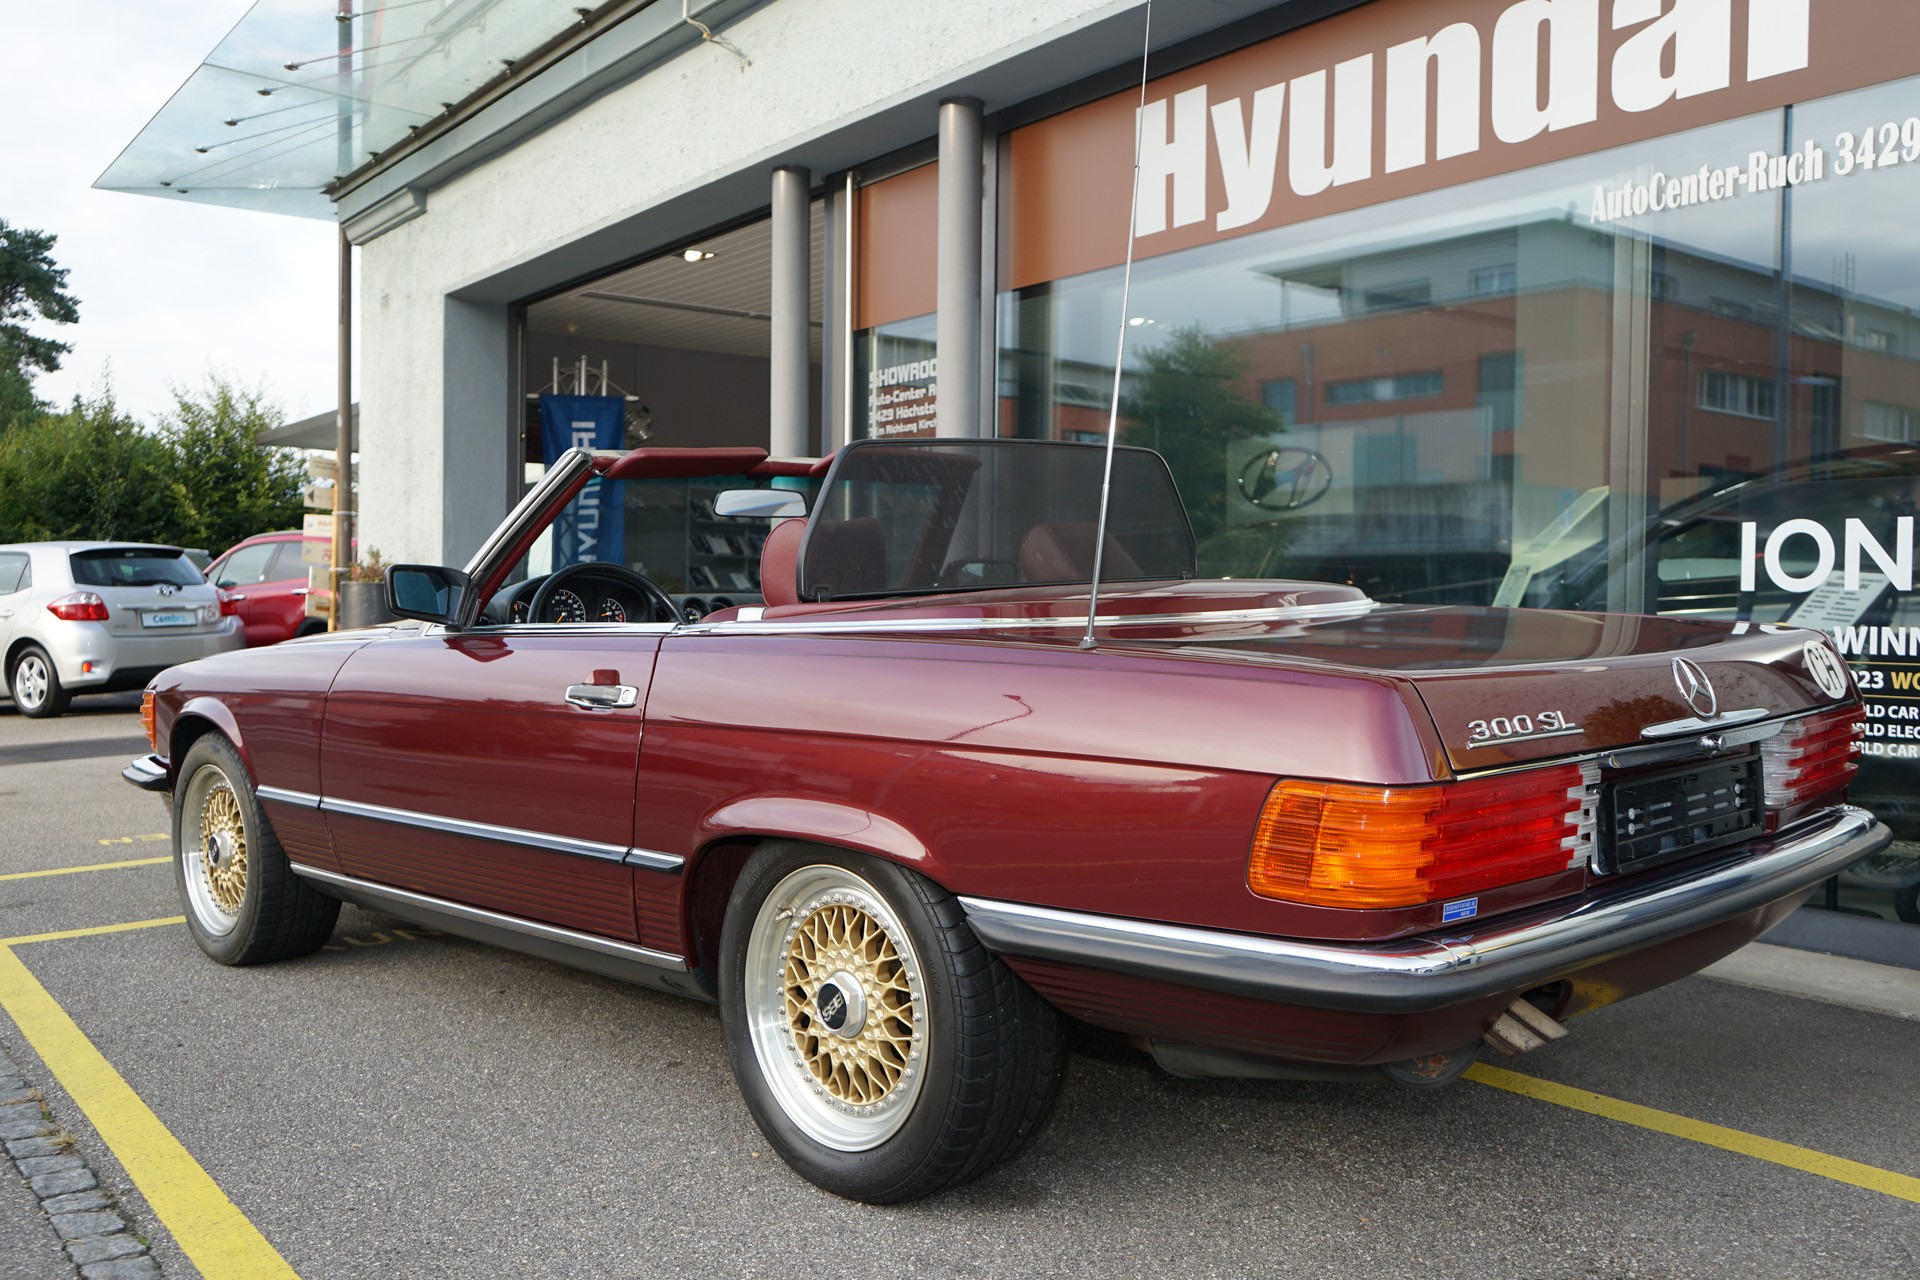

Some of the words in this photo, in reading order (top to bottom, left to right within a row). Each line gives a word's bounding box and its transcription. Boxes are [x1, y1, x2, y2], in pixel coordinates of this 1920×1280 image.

[1590, 139, 1824, 223] AutoCenter-Ruch
[1834, 117, 1920, 176] 3429
[896, 401, 937, 420] Höchste
[571, 421, 601, 563] YUNAI
[1740, 516, 1914, 593] ION
[1807, 646, 1844, 692] CH
[1467, 714, 1534, 741] 300
[1537, 710, 1576, 731] SL
[1863, 704, 1886, 718] LD
[1887, 705, 1919, 720] CAR
[1887, 724, 1920, 740] ELEC
[1886, 743, 1919, 758] CAR
